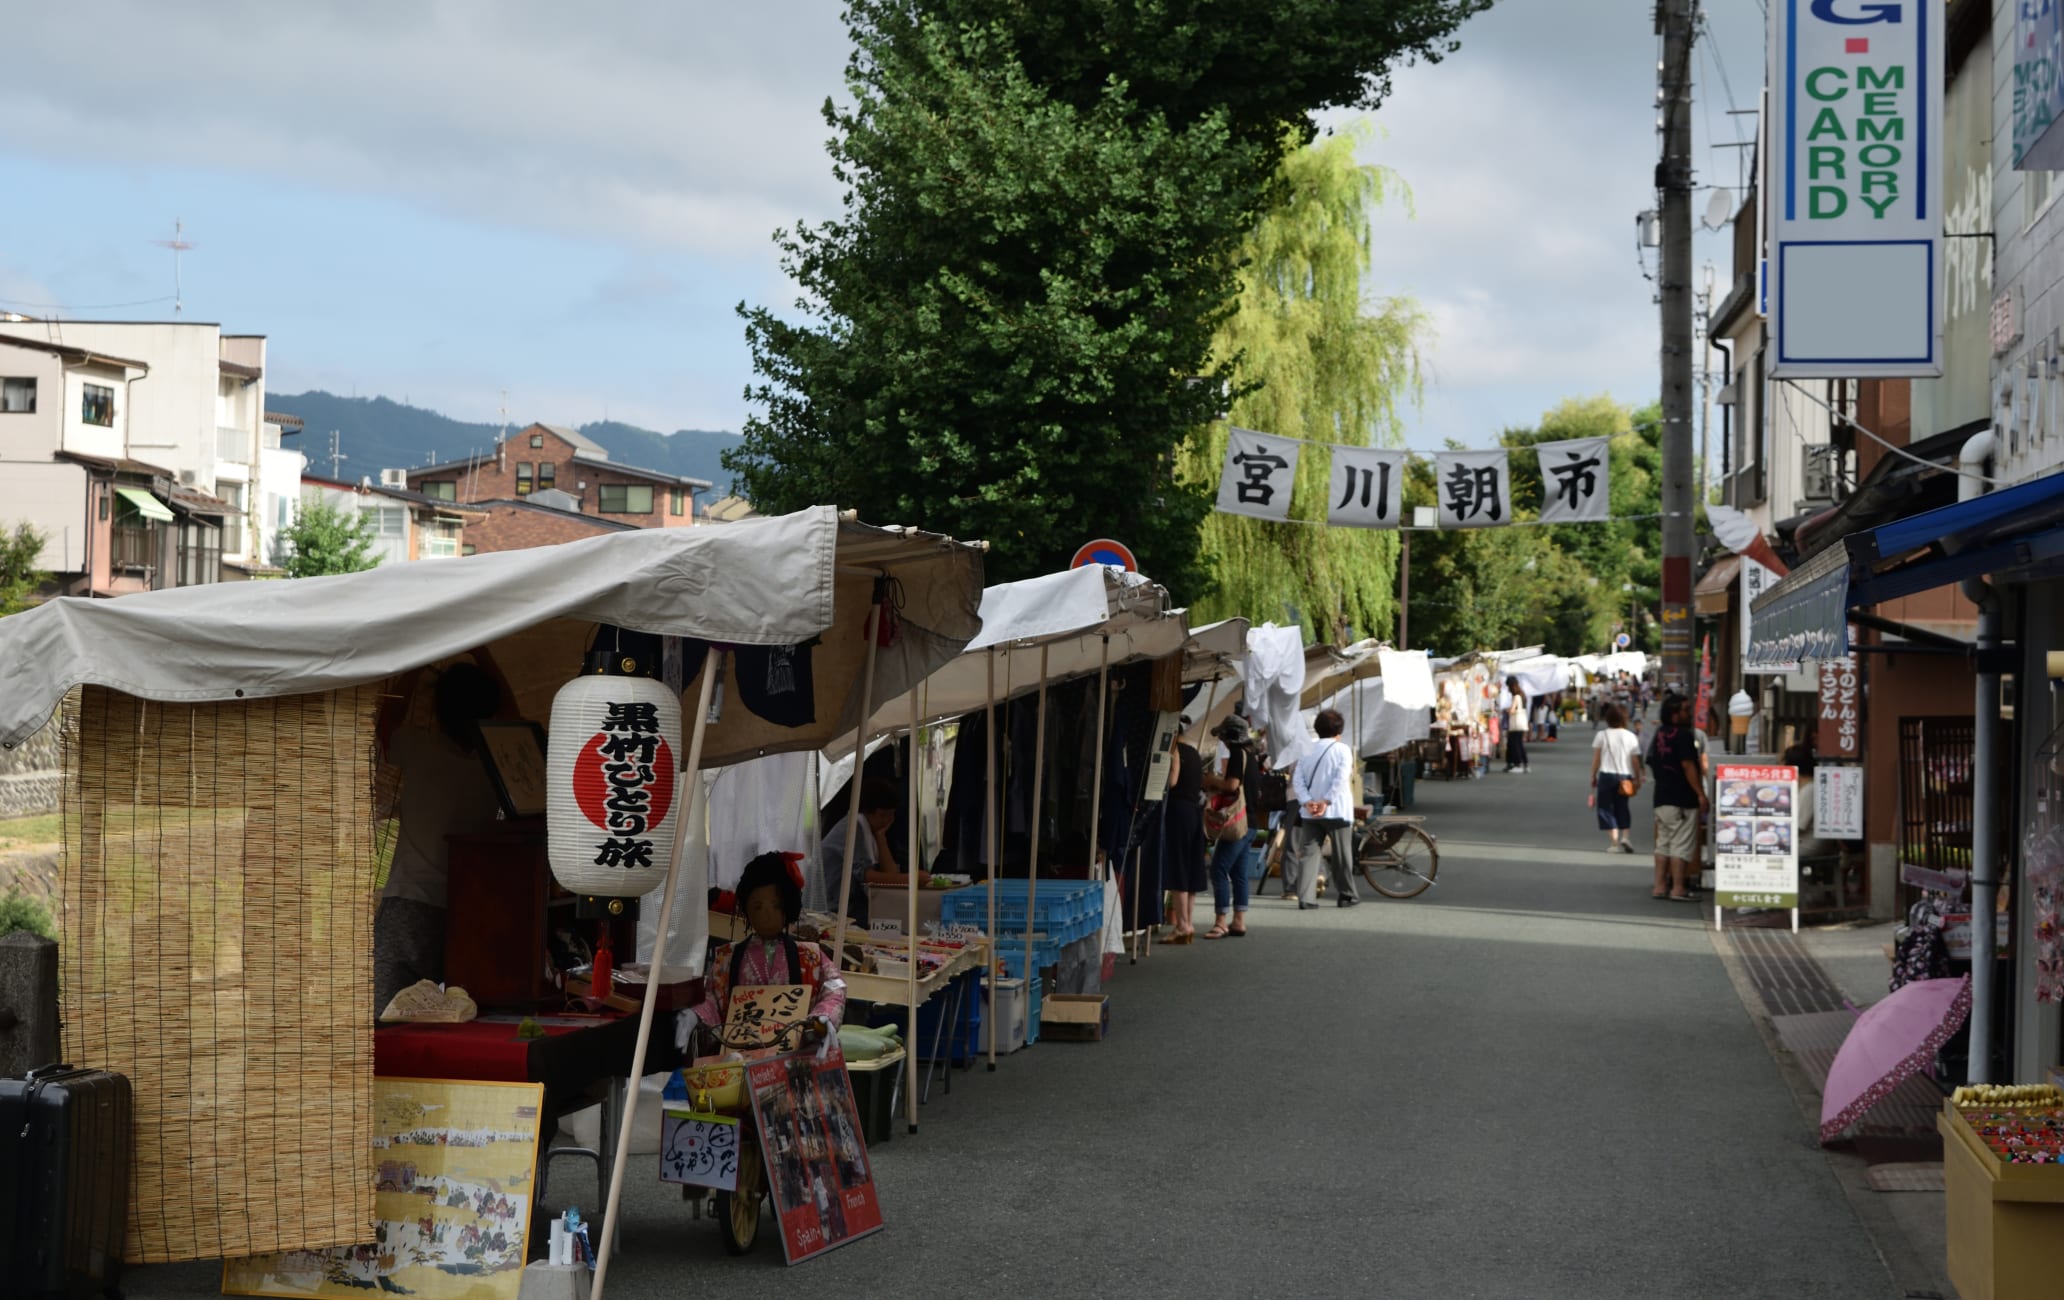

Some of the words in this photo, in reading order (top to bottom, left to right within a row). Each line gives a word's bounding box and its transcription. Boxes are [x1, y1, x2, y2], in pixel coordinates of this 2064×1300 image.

[1805, 67, 1848, 219] CARD
[1856, 66, 1904, 219] MEMORY
[1232, 444, 1601, 520] 宮川朝市
[594, 701, 660, 868] 黒竹ひとり旅
